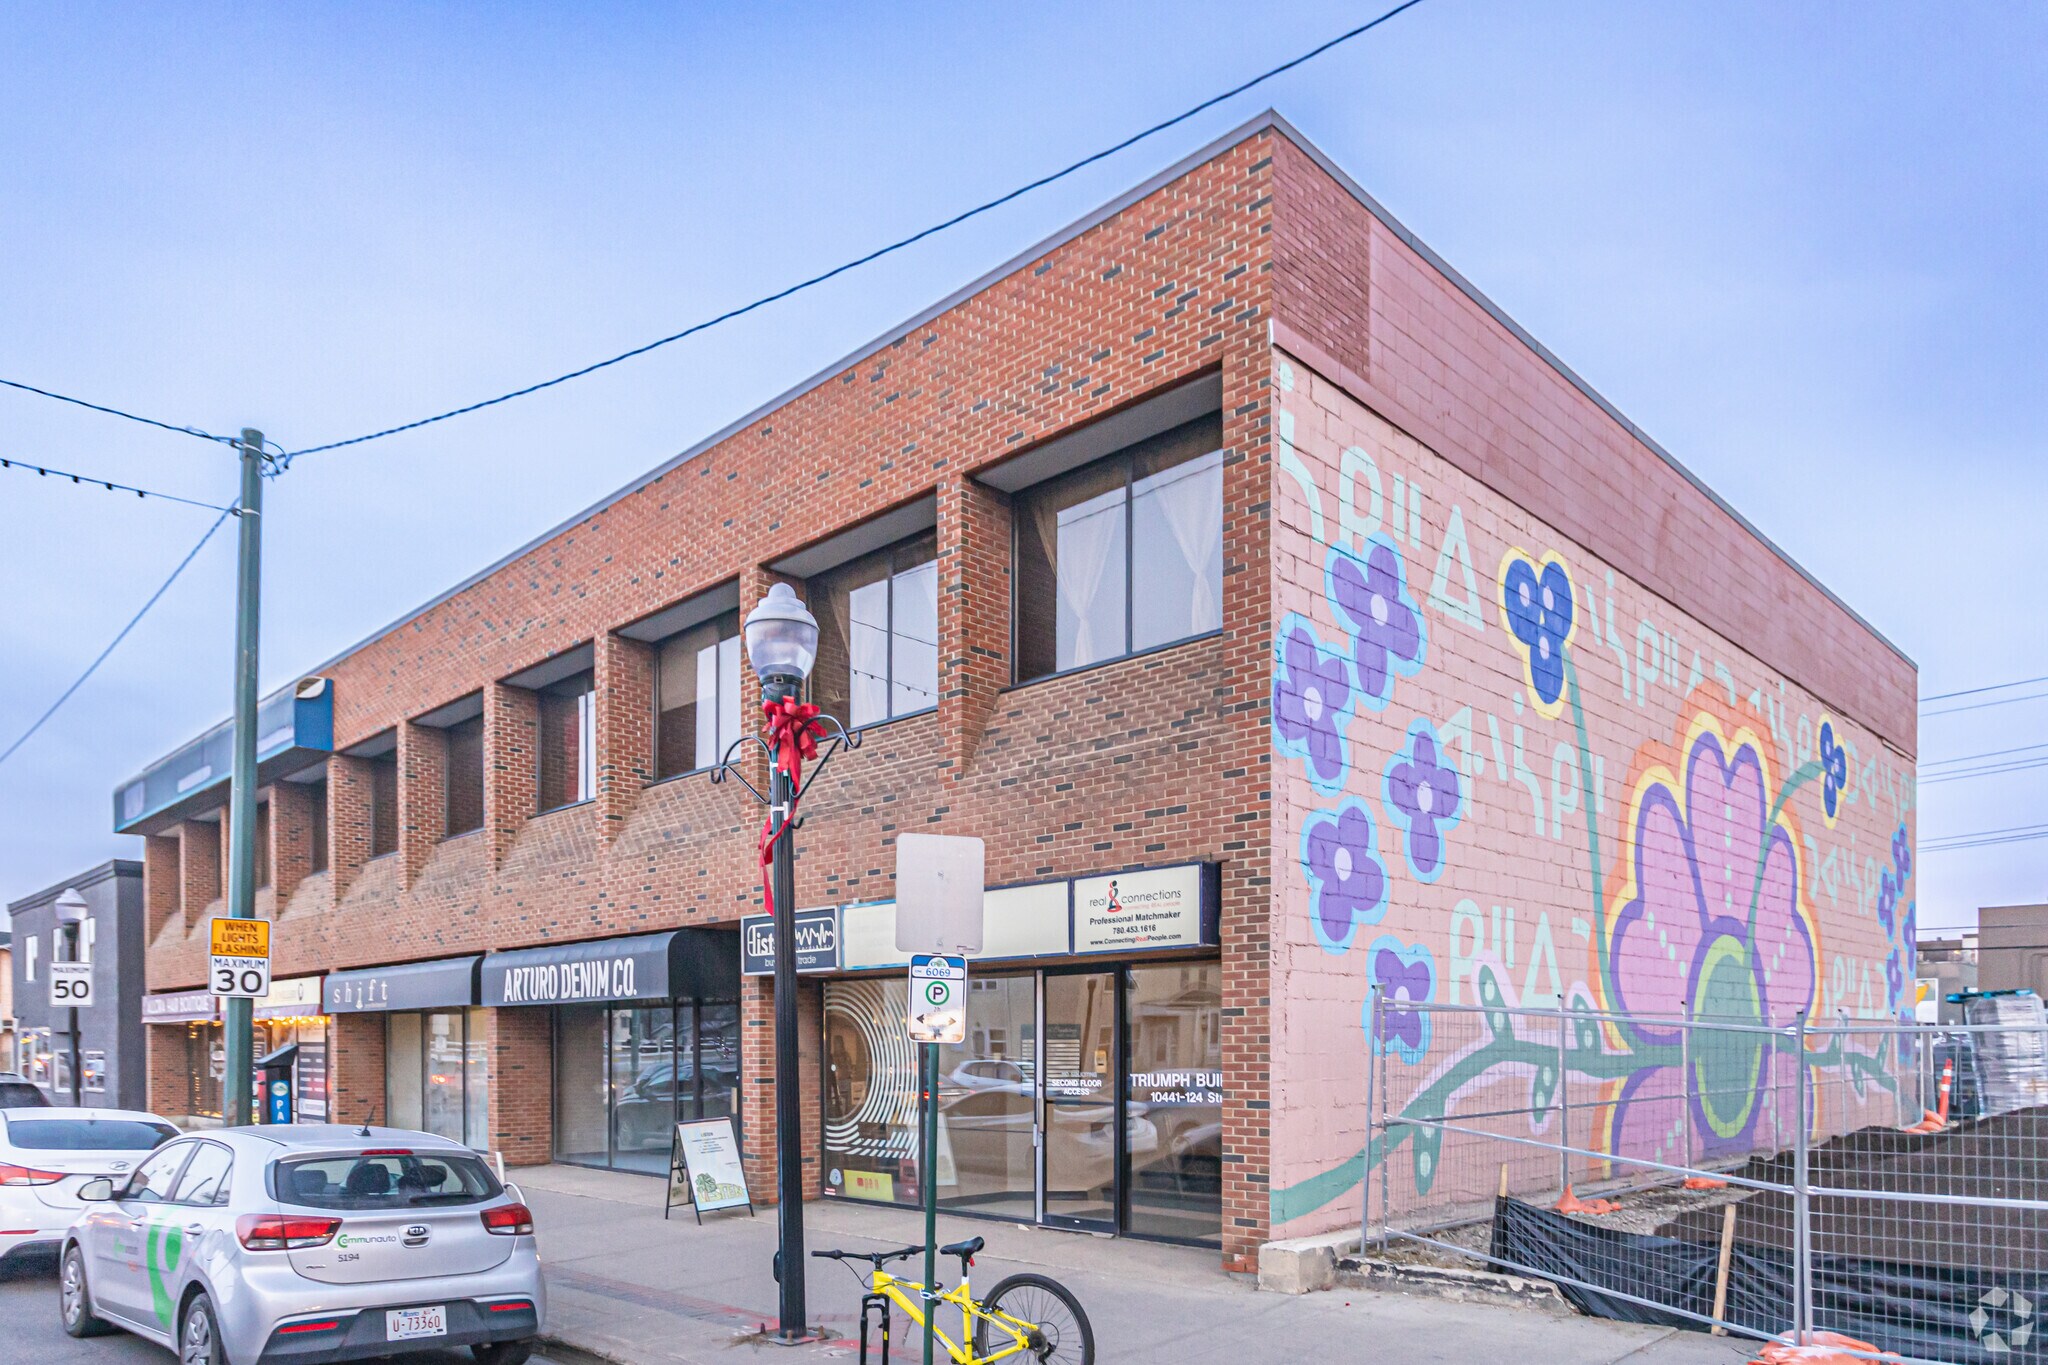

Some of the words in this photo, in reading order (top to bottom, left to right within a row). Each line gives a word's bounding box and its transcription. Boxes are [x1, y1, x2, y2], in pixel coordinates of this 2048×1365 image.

[1089, 895, 1107, 907] real
[1121, 889, 1182, 904] connections
[1089, 914, 1134, 926] Professional
[1135, 910, 1181, 922] Matchmaker
[224, 921, 258, 932] WHEN
[1112, 924, 1157, 935] 780.453.1616
[221, 932, 259, 944] LIGHTS
[1090, 934, 1182, 946] www.ConnectingRealPeople.com
[212, 943, 267, 956] FLASHING
[213, 957, 266, 970] MAXIMUM
[797, 955, 817, 965] trade
[925, 967, 951, 978] 6069
[216, 969, 262, 994] 30
[503, 965, 559, 1003] ARTURO
[560, 959, 610, 1000] DENIM
[612, 957, 638, 997] CO.
[54, 979, 89, 999] 50
[932, 986, 944, 1000] P
[1051, 1079, 1079, 1087] SECOND
[1080, 1079, 1102, 1087] FLOOR
[1130, 1073, 1190, 1088] TRIUMPH
[1195, 1073, 1222, 1088] BUI
[1063, 1088, 1090, 1096] ACCESS
[1150, 1091, 1203, 1103] 10441-124
[408, 1227, 426, 1236] KIA
[337, 1234, 397, 1248] Communauto
[337, 1253, 360, 1263] 5194
[392, 1315, 441, 1332] U-73360
